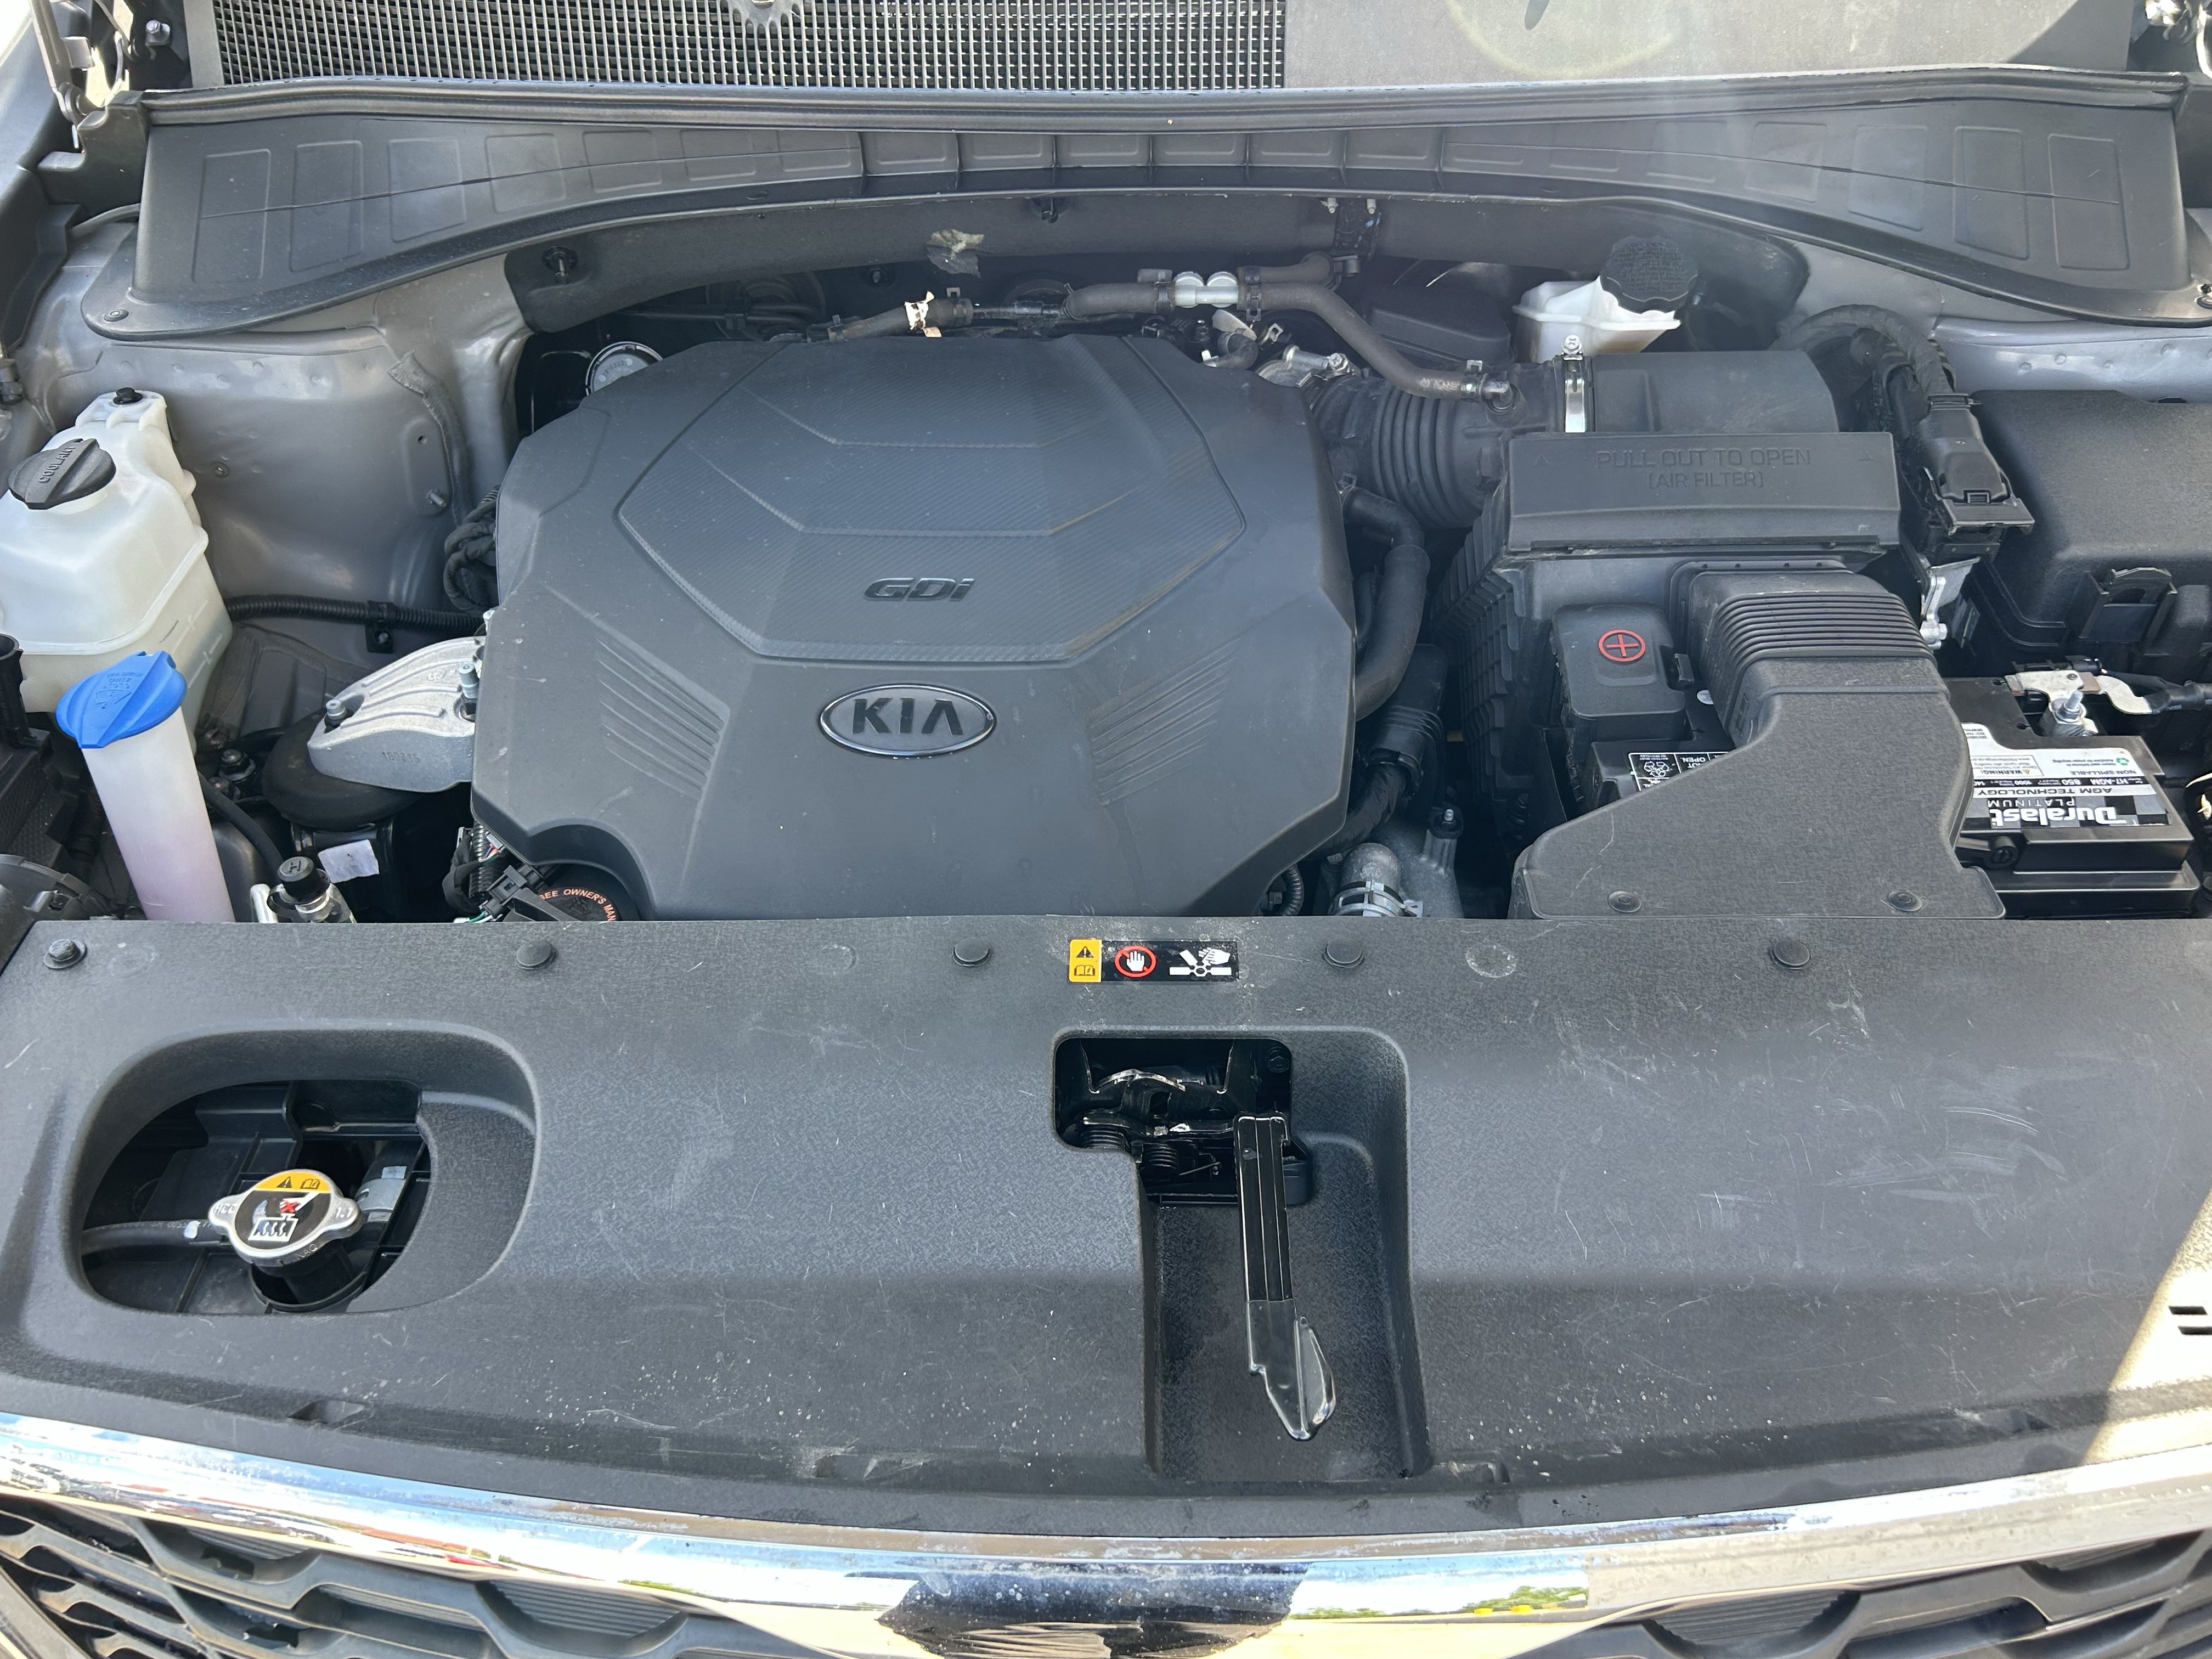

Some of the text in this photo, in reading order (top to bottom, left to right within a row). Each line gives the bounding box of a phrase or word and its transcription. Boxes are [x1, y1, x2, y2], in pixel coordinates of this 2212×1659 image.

[38, 446, 76, 483] COOLANT
[1596, 447, 1811, 469] PULL OUT TO OPEN
[852, 697, 964, 736] KIA
[1987, 796, 2075, 809] PLATINUM
[1989, 806, 2127, 826] Duralast
[563, 888, 607, 905] OWNER'S
[213, 1203, 238, 1215] HCC
[335, 1206, 353, 1218] 1.1
